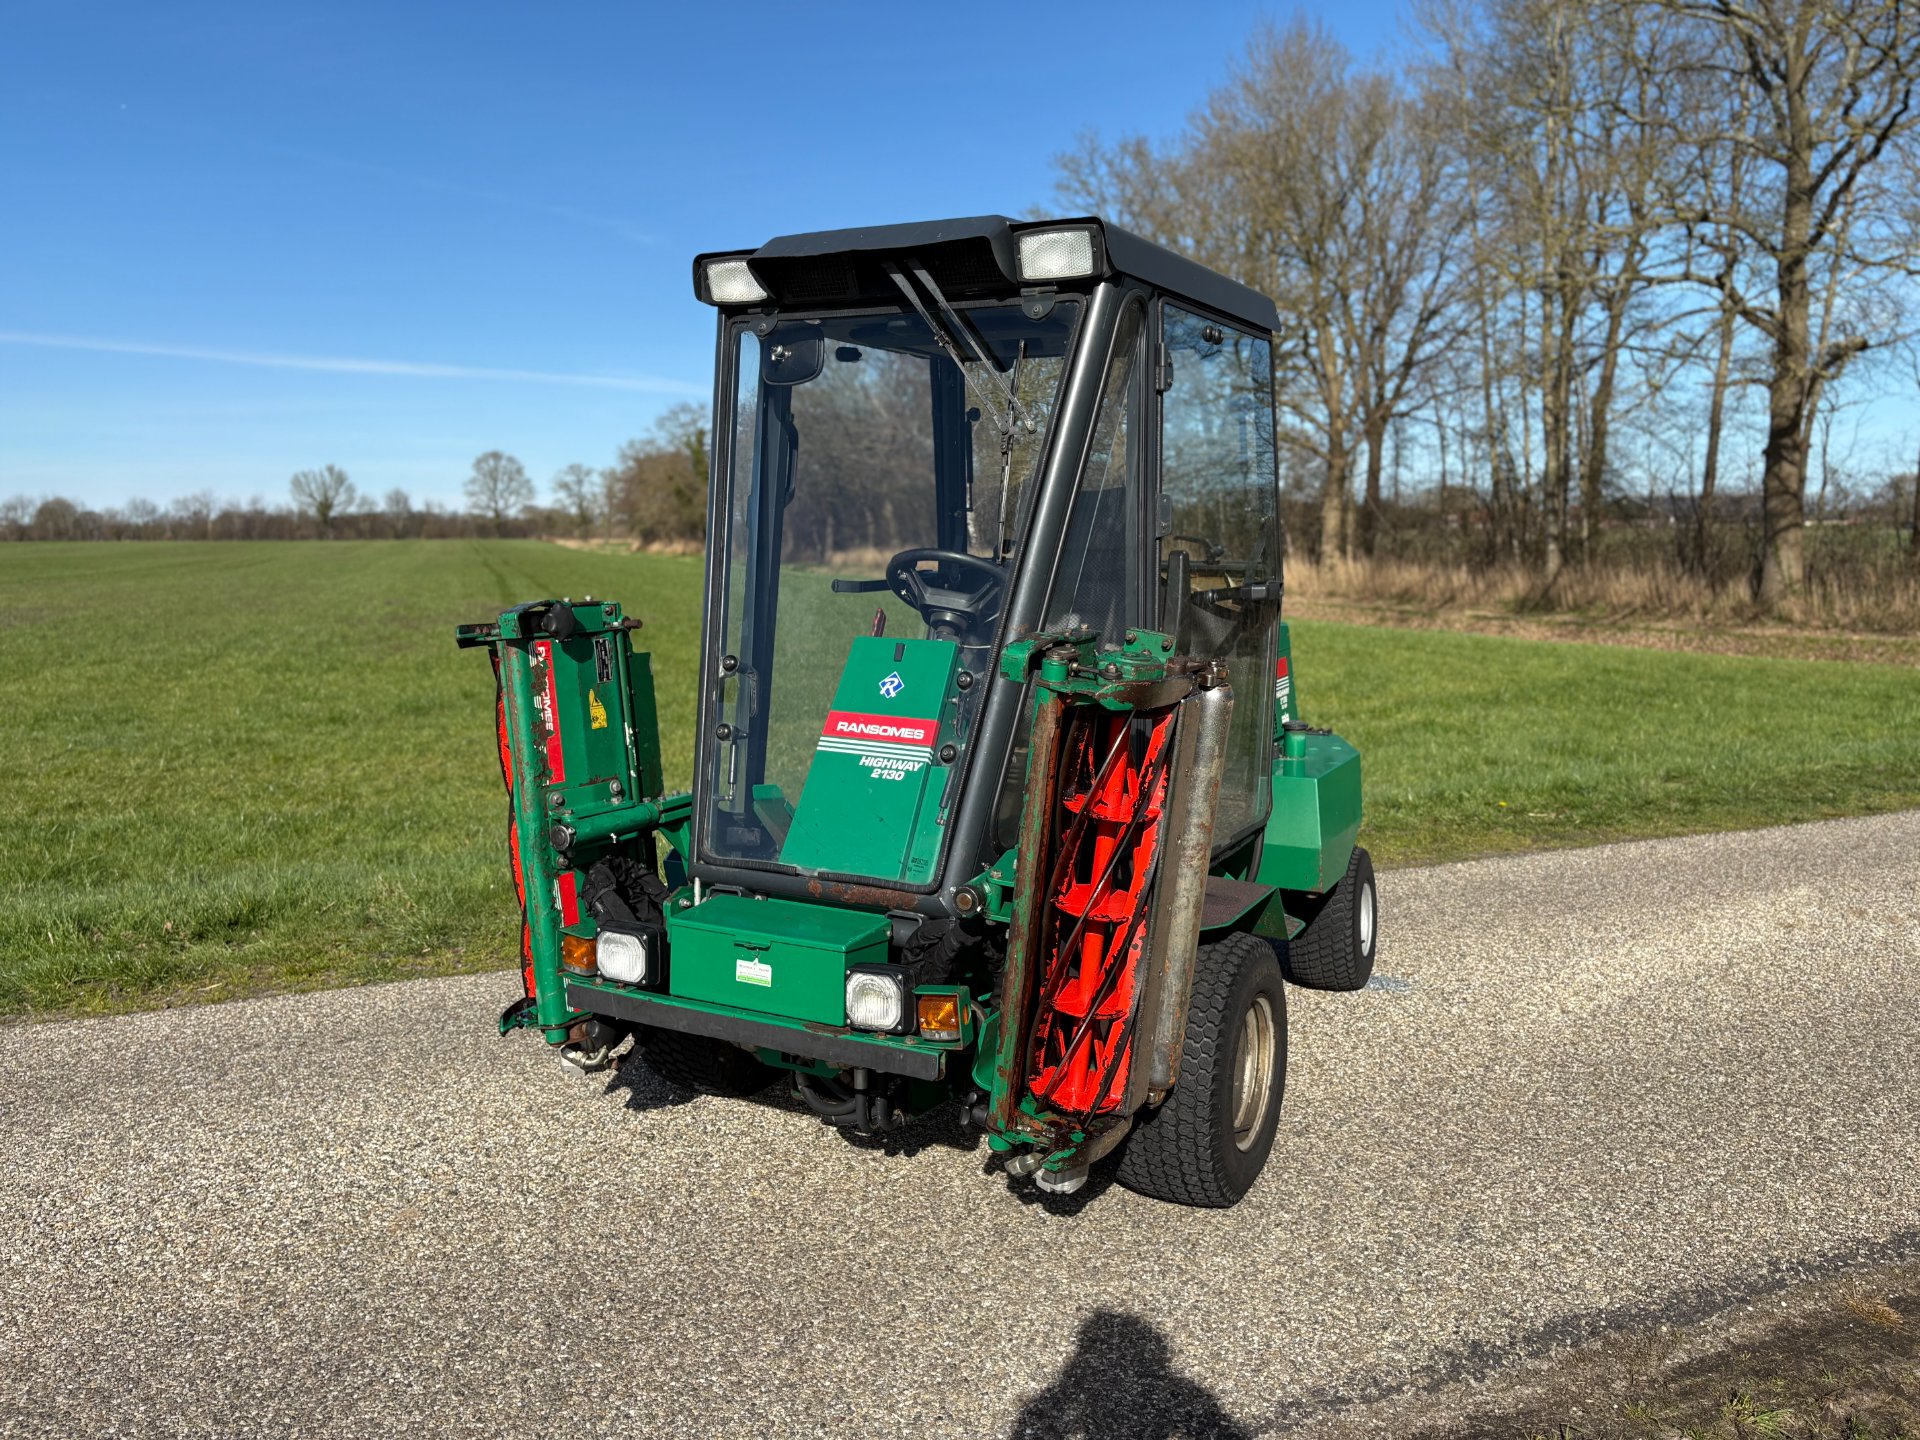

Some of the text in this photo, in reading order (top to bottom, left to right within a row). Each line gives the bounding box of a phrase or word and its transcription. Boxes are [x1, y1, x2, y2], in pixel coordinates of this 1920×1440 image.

[836, 721, 925, 740] RANSOMES
[858, 755, 924, 772] HIGHWAY
[870, 768, 905, 781] 2130
